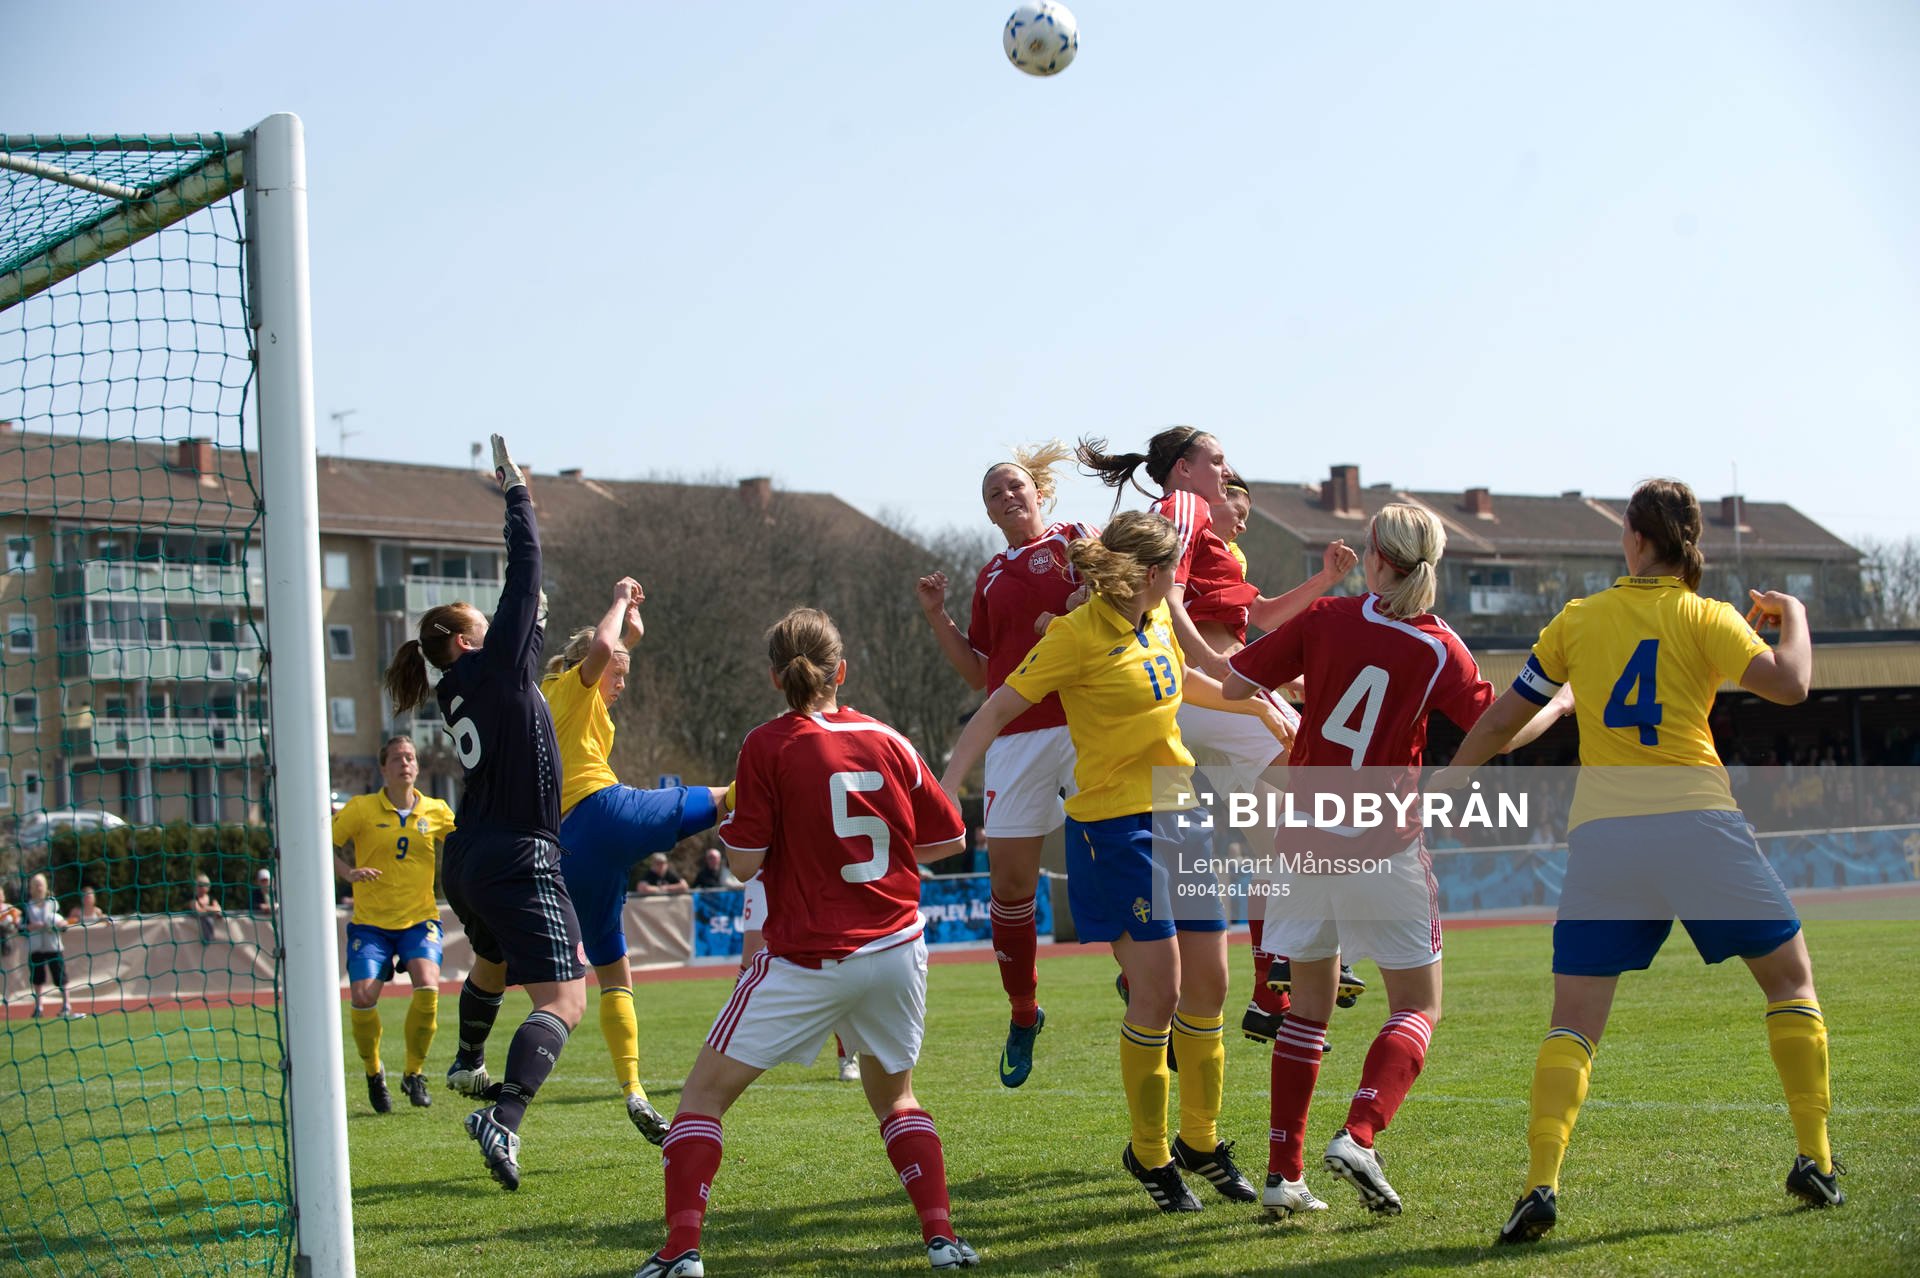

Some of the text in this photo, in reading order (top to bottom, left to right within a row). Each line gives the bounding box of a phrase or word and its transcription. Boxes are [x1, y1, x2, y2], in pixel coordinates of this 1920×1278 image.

[1143, 655, 1177, 701] 13
[1603, 638, 1663, 747] 4
[1321, 665, 1390, 771] 4
[829, 771, 891, 883] 5
[984, 790, 997, 826] 7
[395, 836, 409, 860] 9
[744, 898, 753, 920] 6
[426, 921, 441, 944] 9
